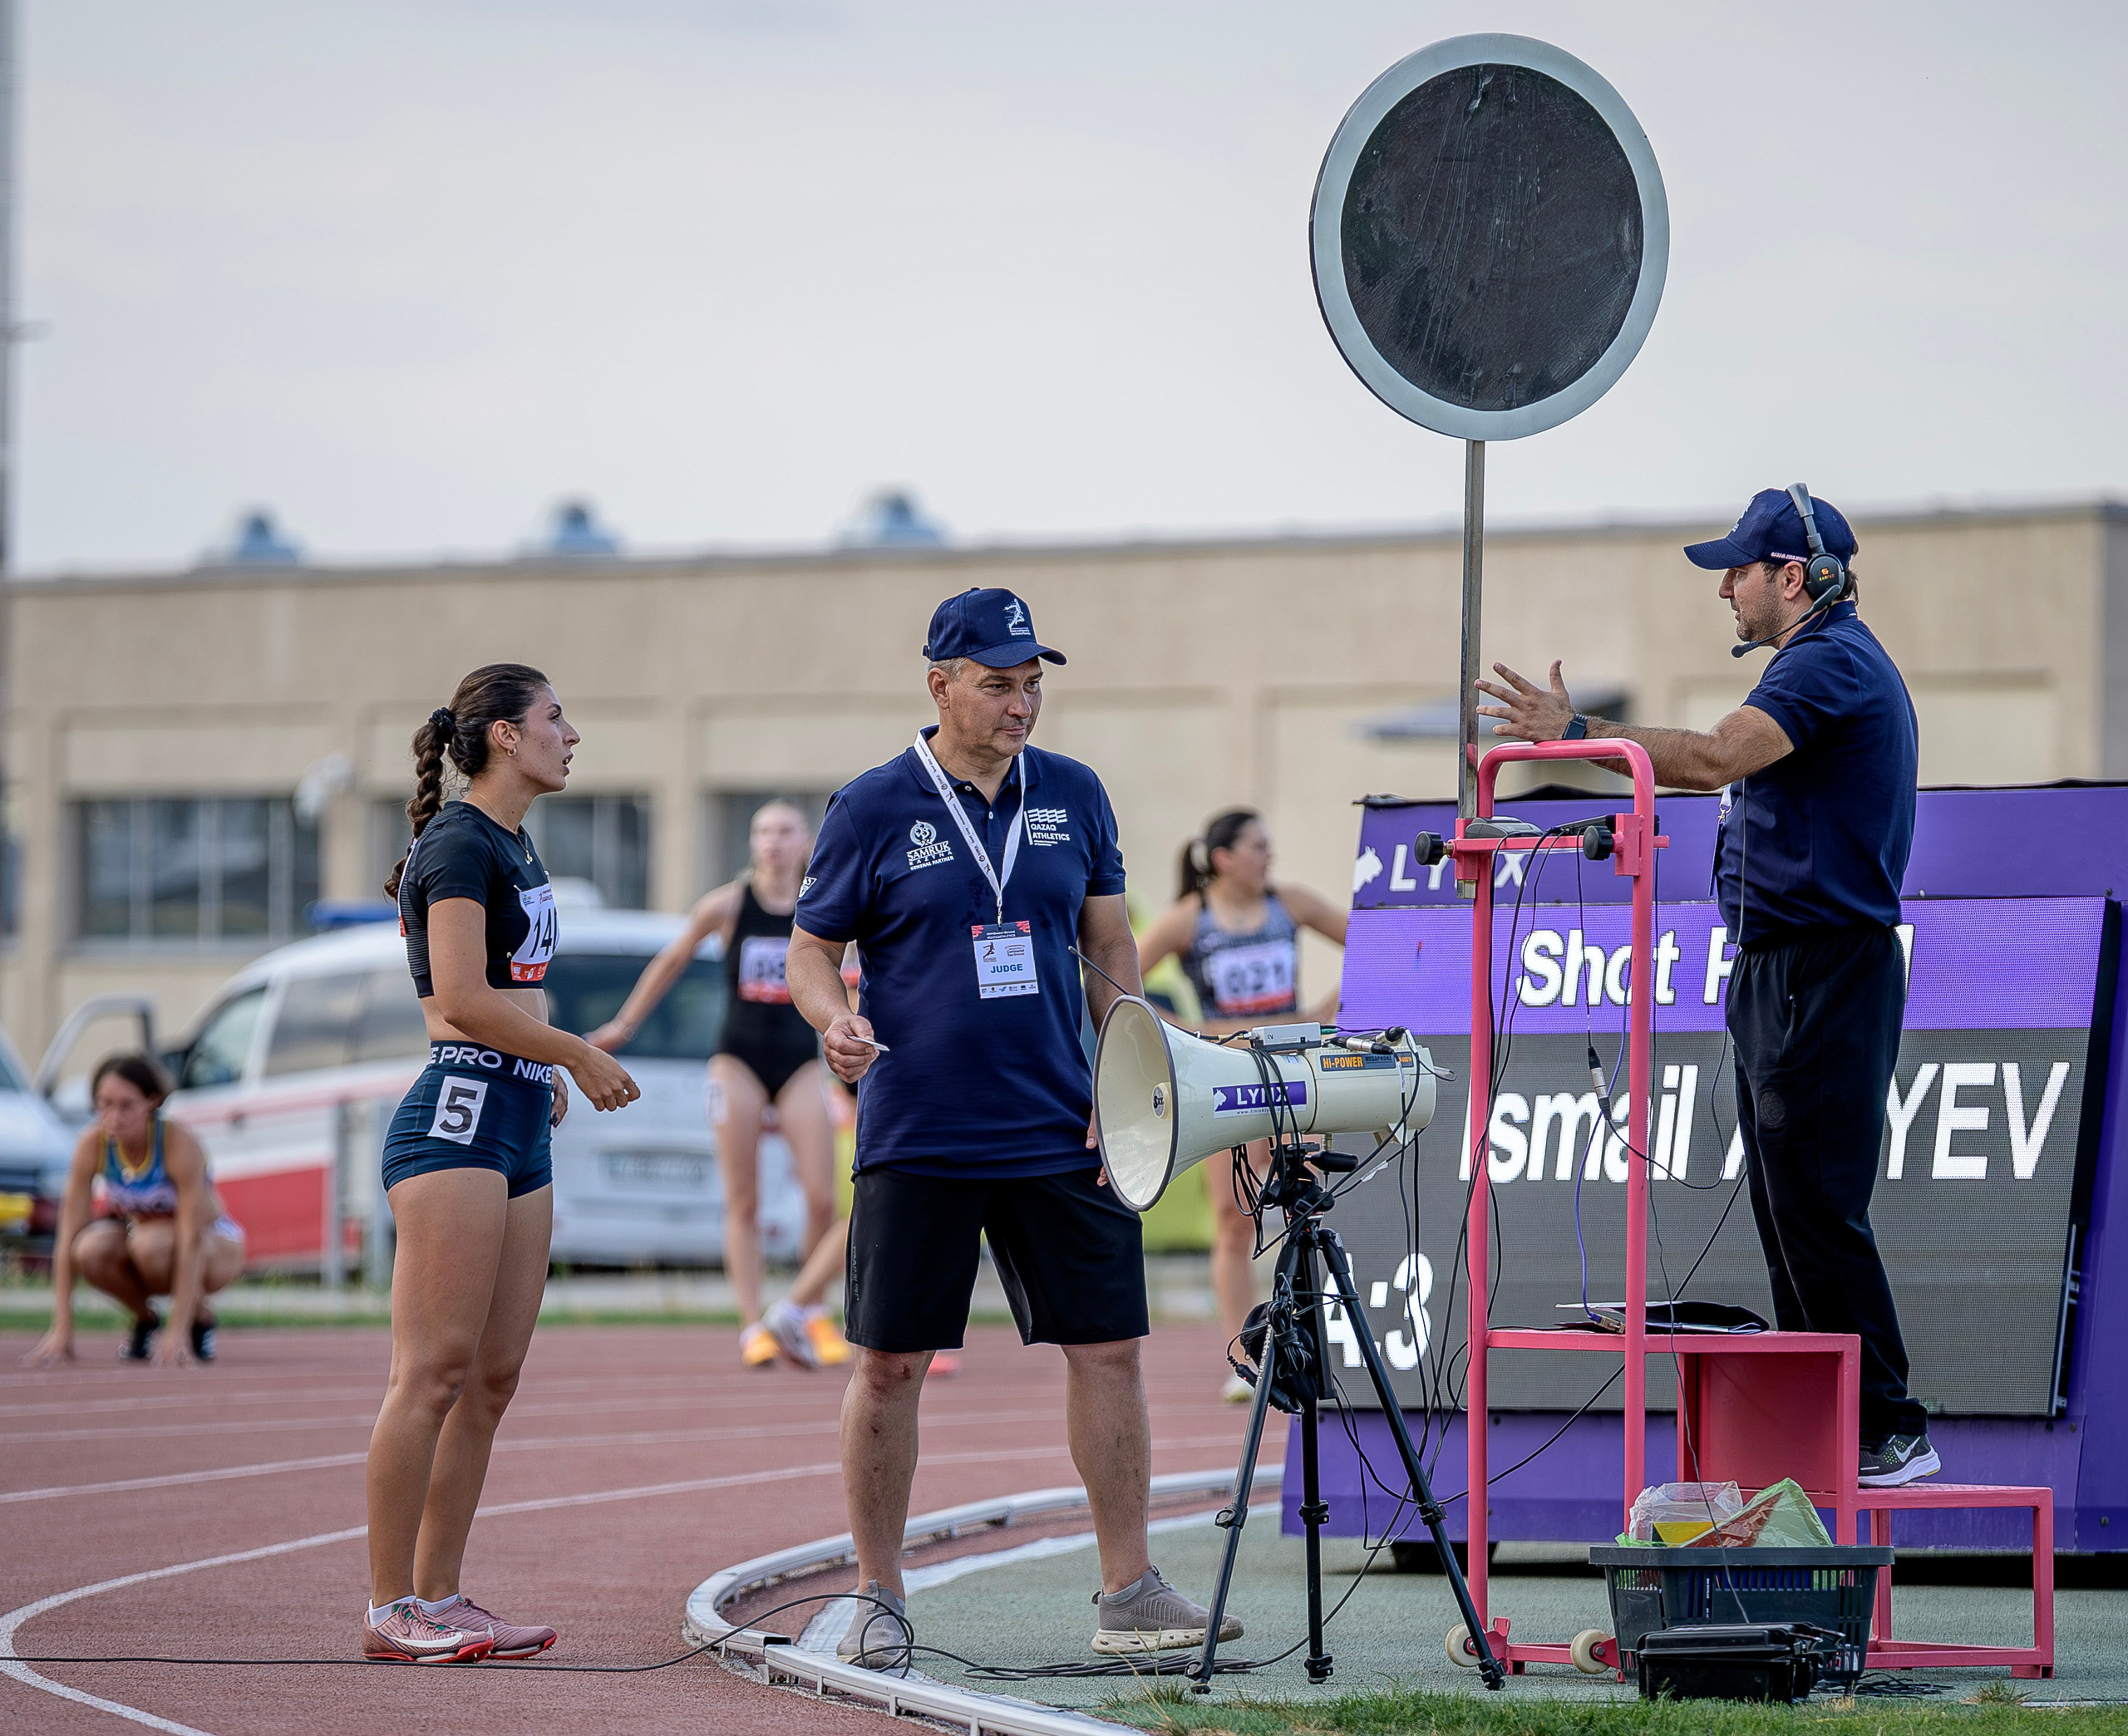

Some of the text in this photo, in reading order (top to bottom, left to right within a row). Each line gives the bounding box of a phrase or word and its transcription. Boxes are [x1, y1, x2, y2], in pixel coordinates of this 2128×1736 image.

[1032, 832, 1070, 841] ATHLETICS
[907, 841, 952, 862] SAMRUK
[1389, 843, 1528, 892] LYX
[990, 963, 1024, 974] JUDGE
[438, 1046, 503, 1069] PRO
[513, 1059, 553, 1084] NIKE
[438, 1085, 478, 1134] 5
